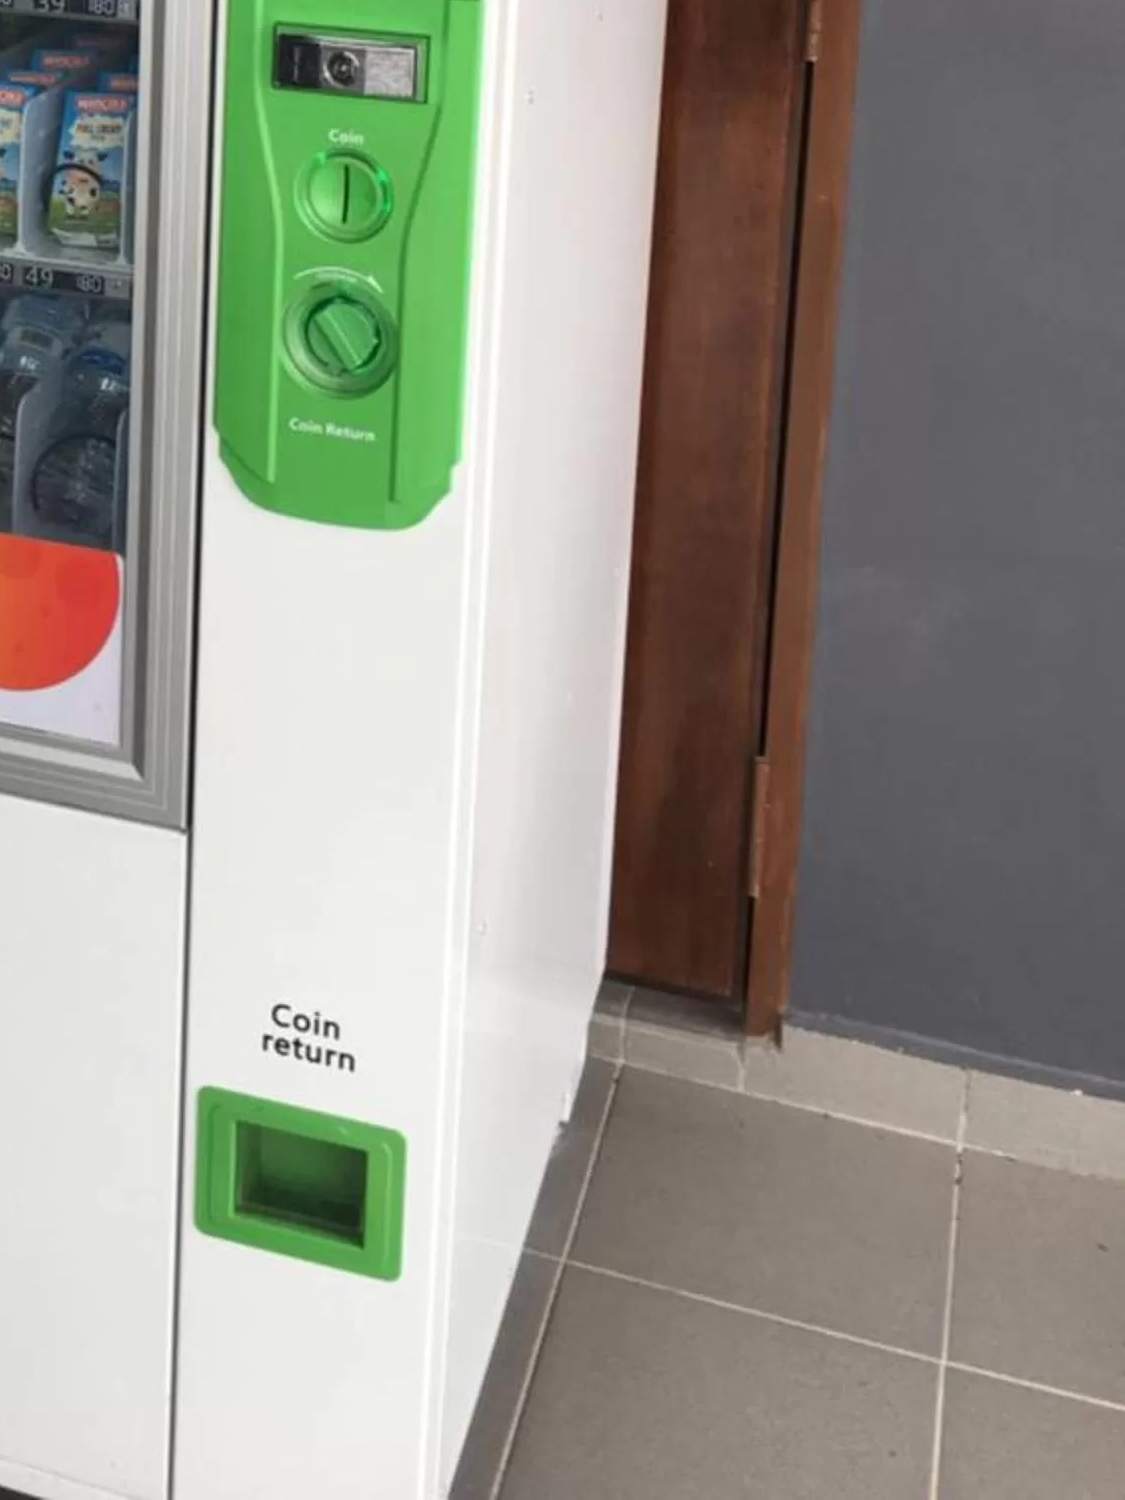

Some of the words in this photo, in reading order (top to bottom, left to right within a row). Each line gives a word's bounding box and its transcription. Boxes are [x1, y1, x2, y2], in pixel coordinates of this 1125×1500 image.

[328, 126, 365, 146] Coin
[25, 267, 55, 287] 49
[288, 416, 323, 436] Coin
[325, 420, 376, 442] Return
[271, 1003, 342, 1041] Coin
[261, 1032, 357, 1073] return
